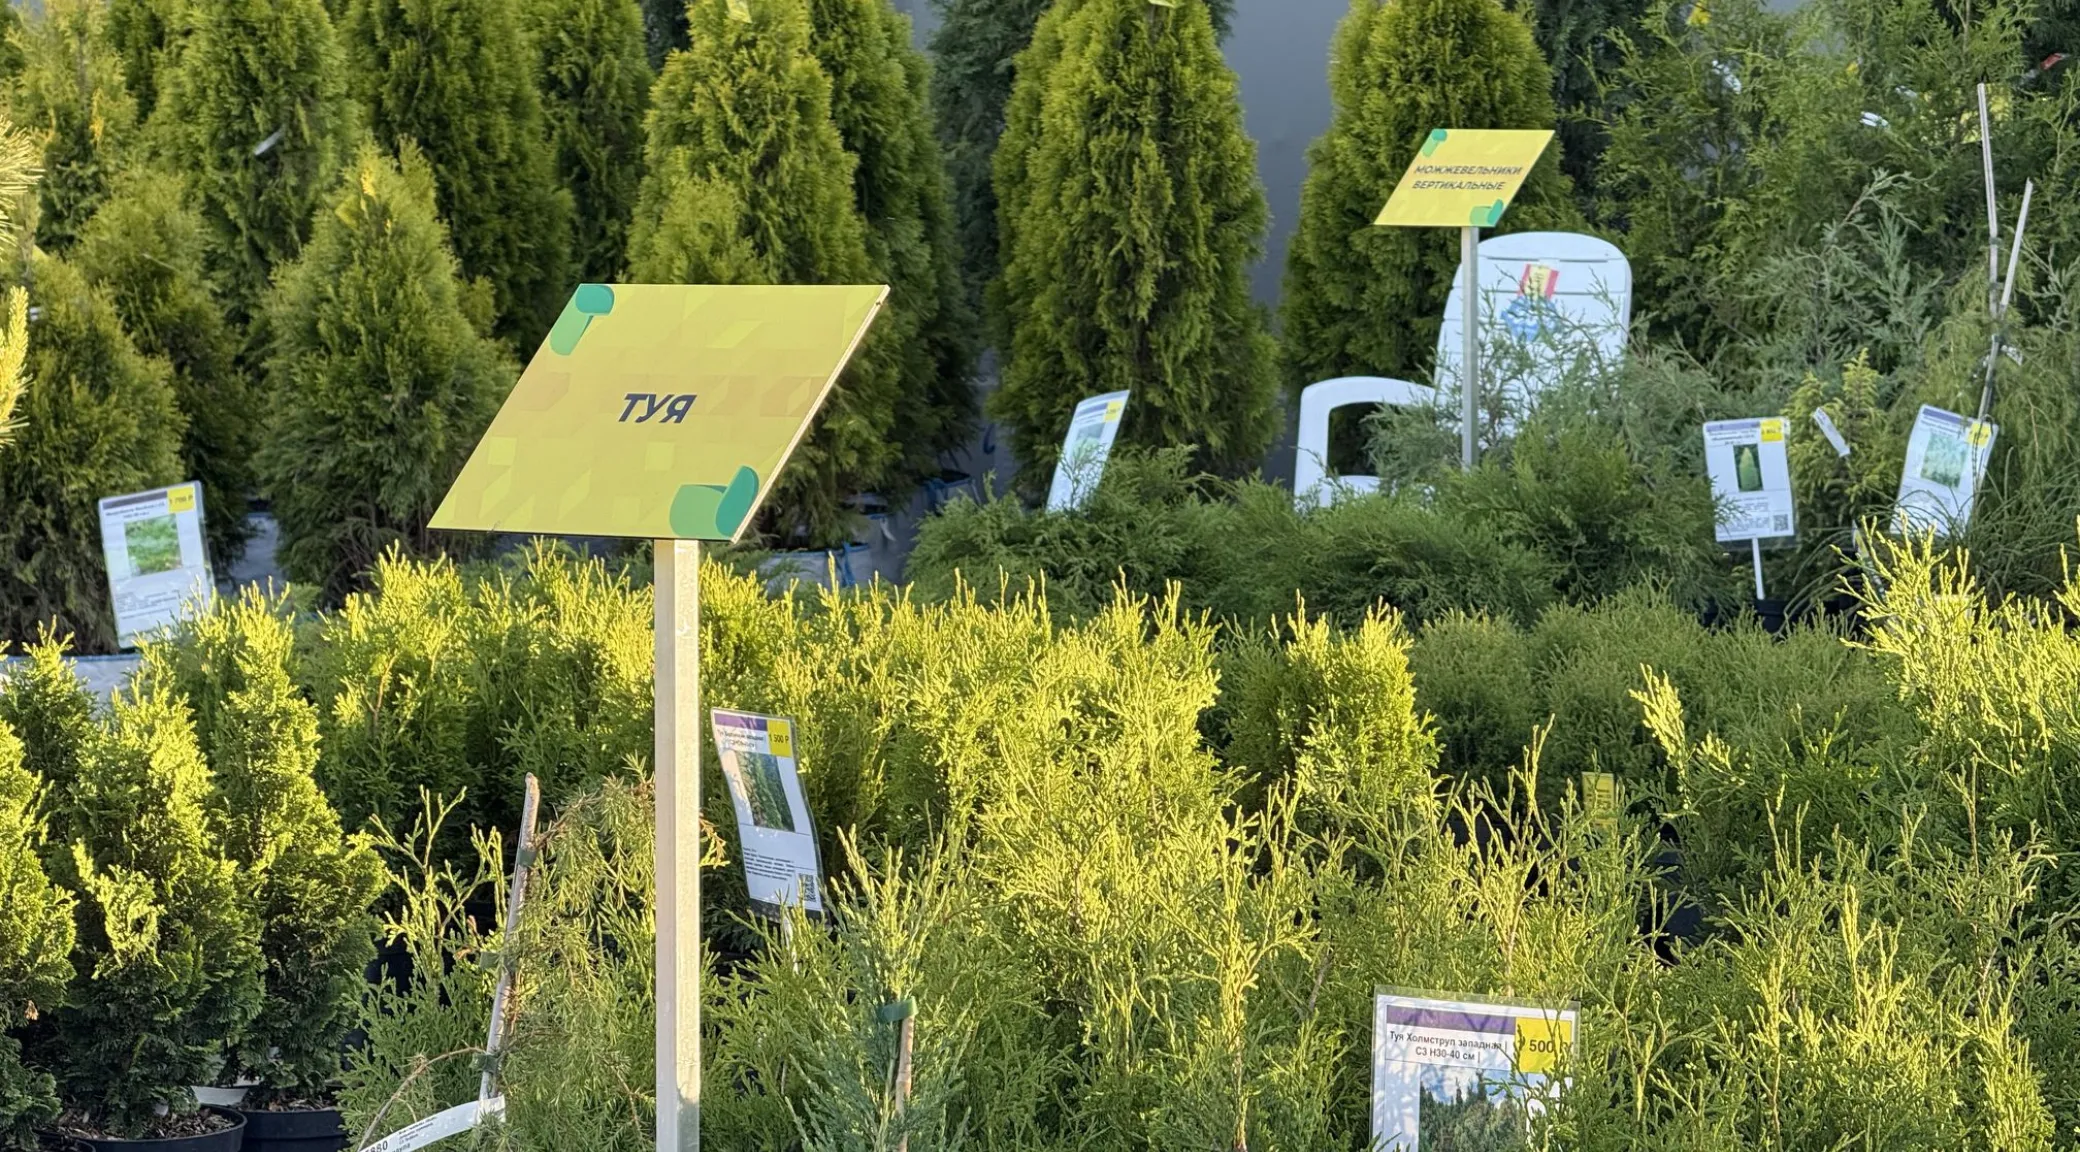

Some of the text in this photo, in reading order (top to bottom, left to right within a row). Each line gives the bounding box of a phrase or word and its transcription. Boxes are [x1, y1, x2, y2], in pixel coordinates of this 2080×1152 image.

[1414, 165, 1522, 175] МОЖЖЕВЕЛЬНИКИ
[1412, 180, 1506, 190] ВЕРТИКАЛЬНЫЕ
[618, 393, 697, 423] ТУЯ
[774, 734, 784, 744] 500
[1390, 1031, 1404, 1043] Туя
[1406, 1032, 1456, 1047] Холмструп
[1529, 1039, 1555, 1054] 500
[1462, 1052, 1475, 1060] см
